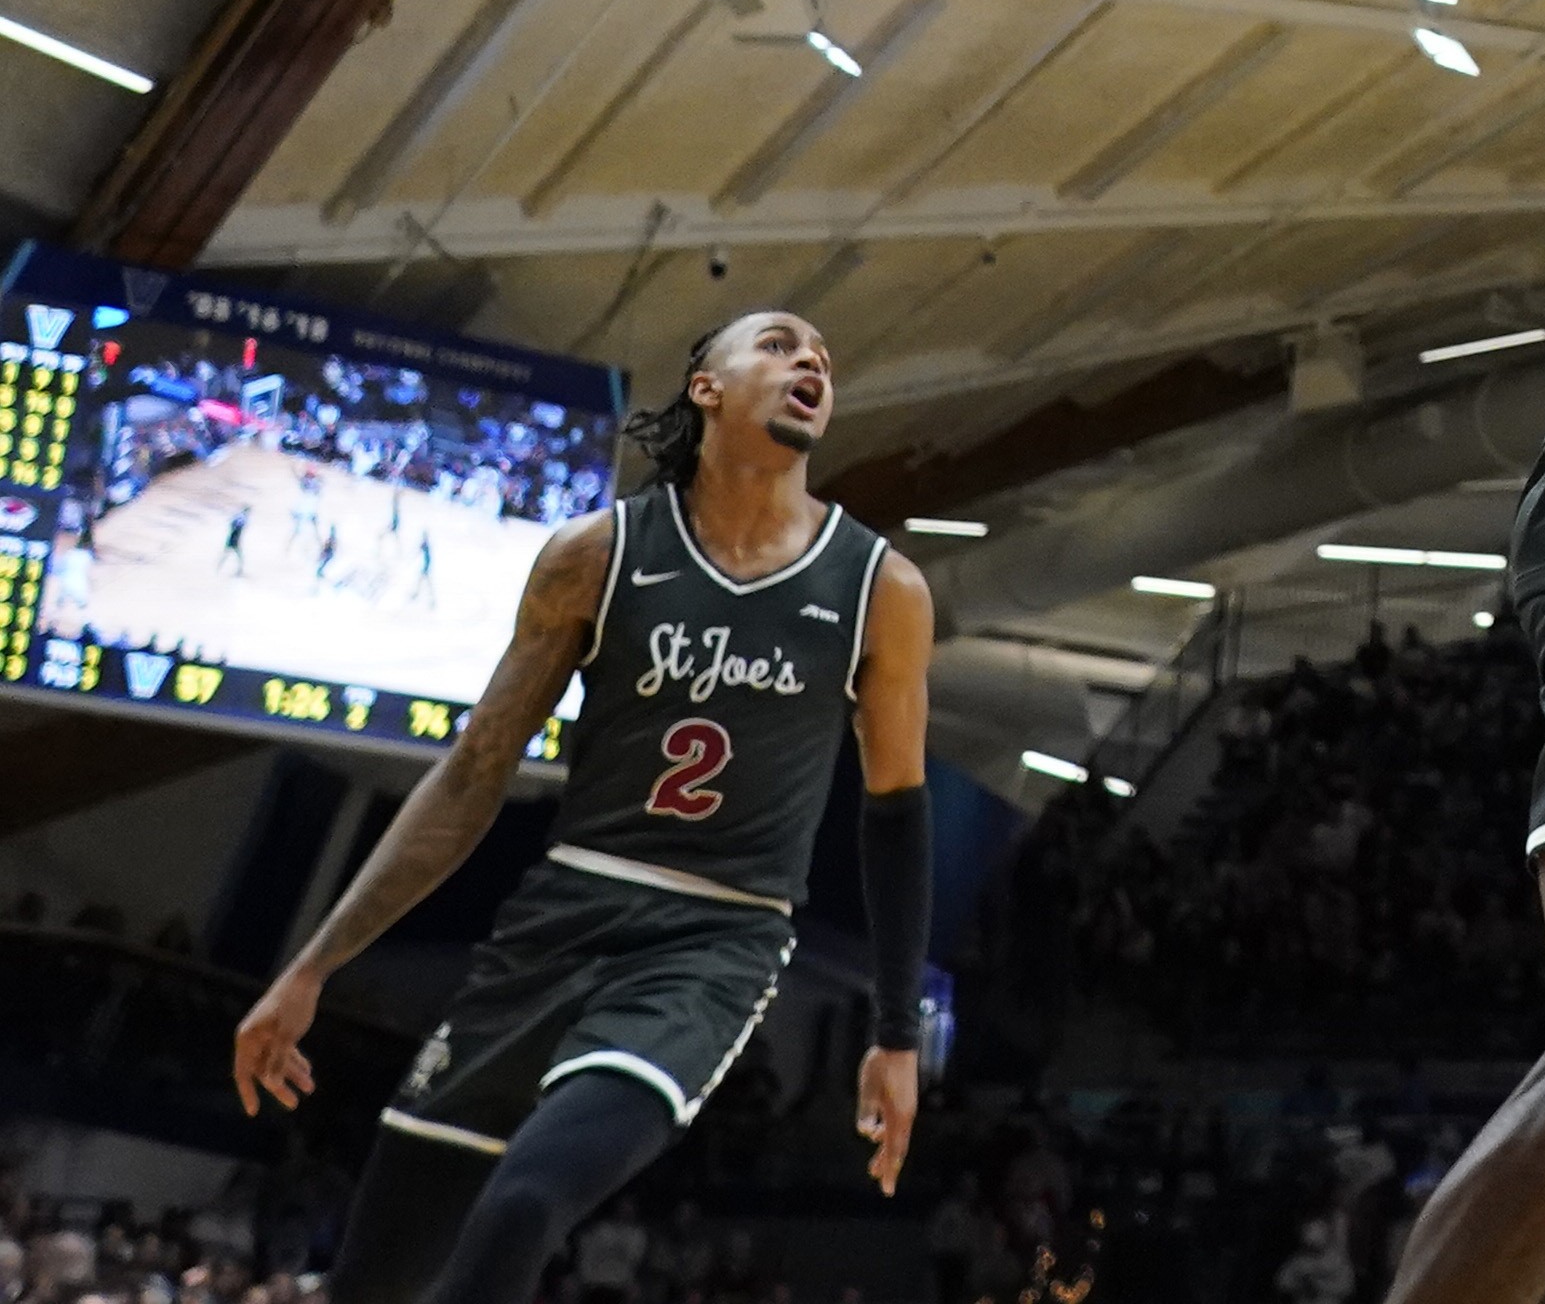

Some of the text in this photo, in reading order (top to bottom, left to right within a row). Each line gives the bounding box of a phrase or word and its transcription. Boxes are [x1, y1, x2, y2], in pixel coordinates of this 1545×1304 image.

[636, 622, 805, 702] St. Joe's
[645, 717, 733, 821] 2
